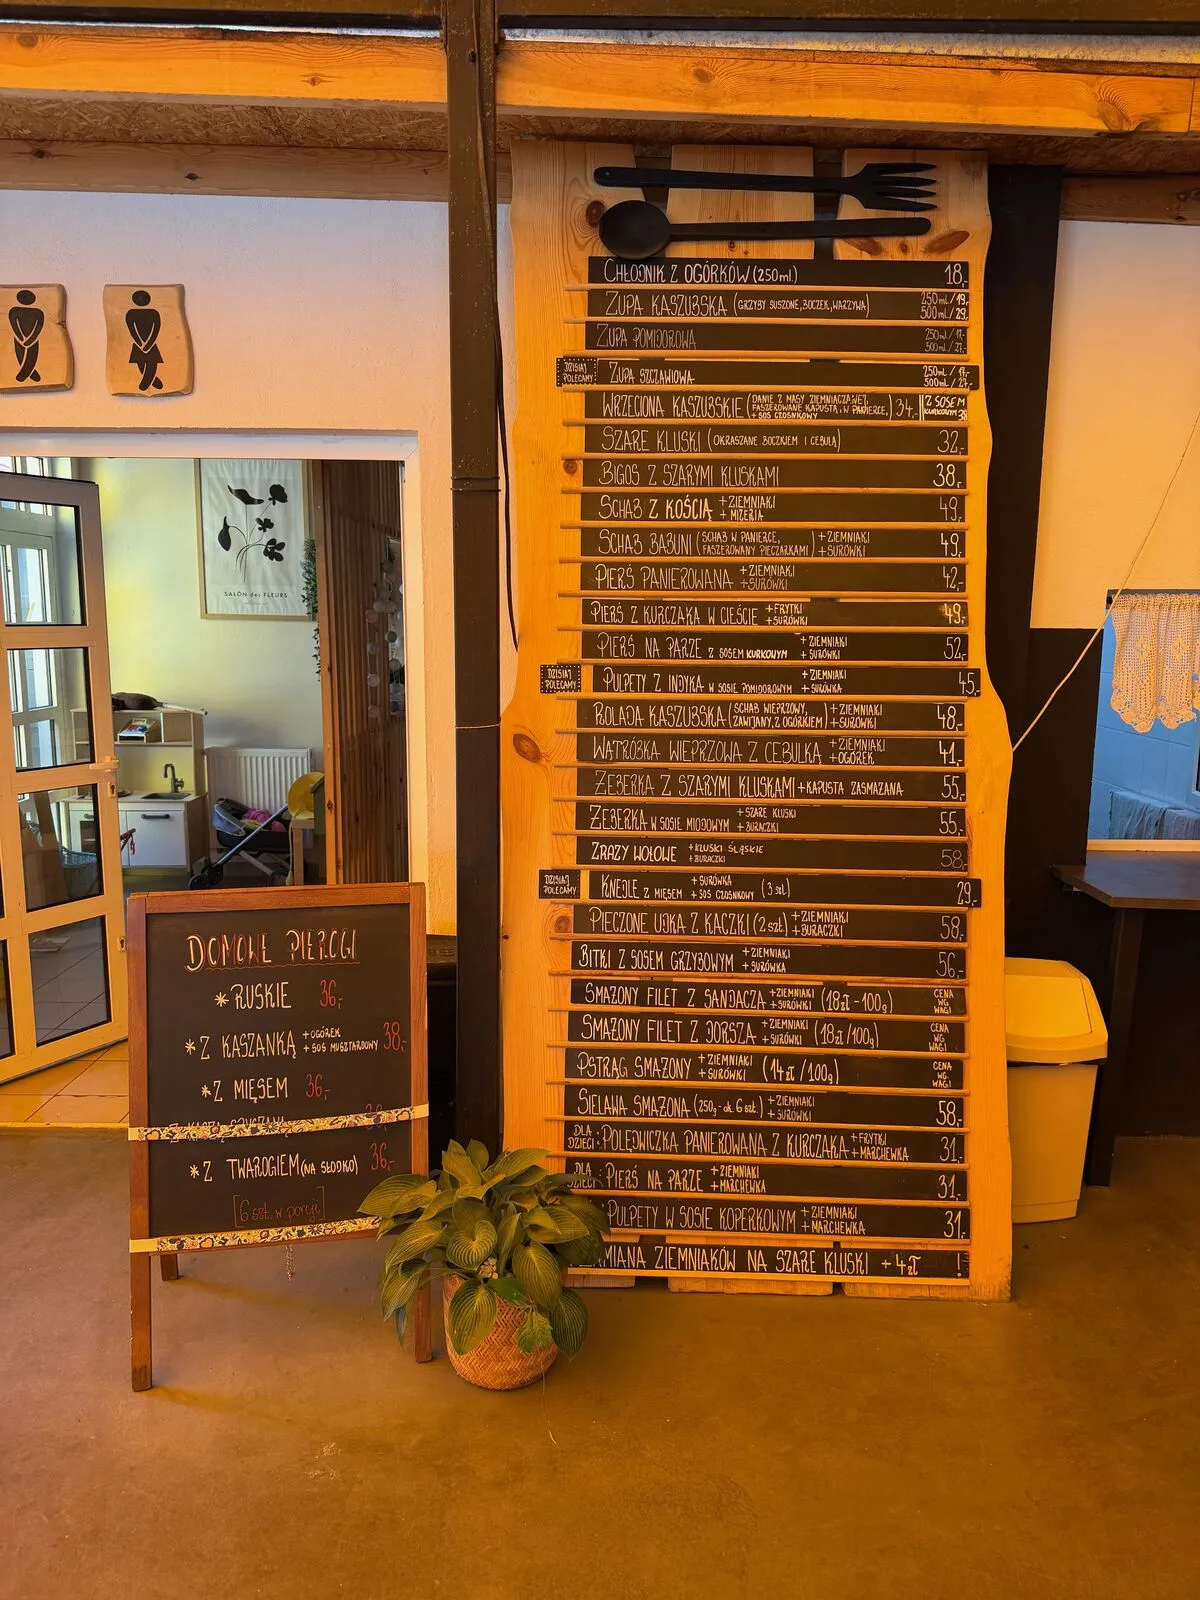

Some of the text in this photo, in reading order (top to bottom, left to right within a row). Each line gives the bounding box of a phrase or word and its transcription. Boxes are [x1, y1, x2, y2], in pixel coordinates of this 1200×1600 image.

[604, 259, 968, 287] CHŁODNIK Z OGÓRKÓW 18,-
[605, 291, 728, 316] ZUPA KASZUBSKA
[597, 324, 696, 349] ZUPA POMIDOROWA
[563, 374, 593, 383] POLECAMY
[609, 362, 695, 384] ZUPA SZCZAWIOWA
[602, 392, 744, 418] WRZECIONA KASZUBSKIE
[602, 426, 649, 450] SZARE
[657, 430, 700, 452] KLUSKI
[762, 435, 798, 446] BOCZKIEM
[938, 430, 964, 455] 32,-
[599, 461, 639, 485] BIGOS
[648, 464, 657, 485] Z
[663, 464, 713, 486] SZARYMI
[721, 464, 779, 487] KLUSKAMI
[599, 494, 713, 522] SCHAB Z KOŚCIĄ
[599, 529, 692, 555] SCHAB BABUNI
[941, 533, 962, 558] 49,-
[595, 564, 963, 592] PIERŚ PANIEROWANA 42,-
[590, 601, 758, 625] PIERŚ Z KURCZAKA W CIEŚCIE
[596, 632, 635, 658] PIERŚ
[645, 637, 660, 658] NA
[666, 636, 702, 659] PARZE
[720, 649, 744, 659] SOSEM
[545, 680, 576, 689] POLECAMY
[603, 667, 646, 692] PULPETY
[654, 674, 661, 692] Z
[669, 674, 704, 692] INDYKA
[718, 684, 738, 693] SOSIE
[593, 702, 727, 728] ROLADA KASZUBSKA
[937, 705, 963, 731] 48,-
[593, 736, 962, 766] WĄTRÓBKA WIEPRZOWA Z CEBULKĄ 41,-
[660, 774, 671, 795] Z
[679, 775, 730, 797] SZARYMI
[739, 776, 795, 798] KLUSKAMI
[941, 775, 965, 801] 55,-
[660, 817, 682, 830] SOSIE
[687, 819, 729, 832] MIODOWYM
[939, 812, 963, 836] 55,-
[592, 842, 629, 860] ZRAZY
[634, 845, 677, 862] WOŁOWE
[543, 886, 576, 895] POLECAMY
[602, 874, 639, 898] KNEDLE
[655, 888, 682, 900] MIĘSEM
[589, 907, 964, 940] PIECZONE UDKA Z KACZKI 58,-
[185, 928, 357, 971] DOMOWE PIEROGI
[579, 944, 611, 968] BITKI
[619, 949, 625, 968] Z
[631, 949, 663, 970] SOSEM
[671, 950, 734, 972] GRZYBOWYM
[585, 982, 954, 1009] SMAŻONY FILET Z SANDACZA CENA
[581, 1013, 949, 1044] SMAŻONY FILET Z DORSZA CENA
[222, 1031, 296, 1058] KASZANKĄ
[577, 1052, 691, 1080] PSTRĄG SMAŻONY
[234, 1077, 288, 1103] MIĘSEM
[577, 1088, 628, 1115] SIELAWA
[634, 1096, 690, 1118] SMAŻONA
[568, 1138, 594, 1149] DZIECI
[574, 1125, 592, 1136] DLA
[601, 1125, 963, 1164] POLĘDWICZKA PANIEROWANA Z KURCZAKA 31,-
[227, 1152, 300, 1179] TWAROGIEM
[606, 1163, 638, 1189] PIERŚ
[648, 1170, 663, 1190] NA
[668, 1170, 703, 1192] PARZE
[938, 1175, 961, 1200] 31,-
[607, 1200, 658, 1227] PULPETY
[666, 1207, 674, 1227] W
[680, 1206, 713, 1229] SOSIE
[719, 1207, 796, 1233] KOPERKOWYM
[579, 1245, 868, 1274] MIANA ZIEMNIAKÓW NA SZARE KLUSKI
